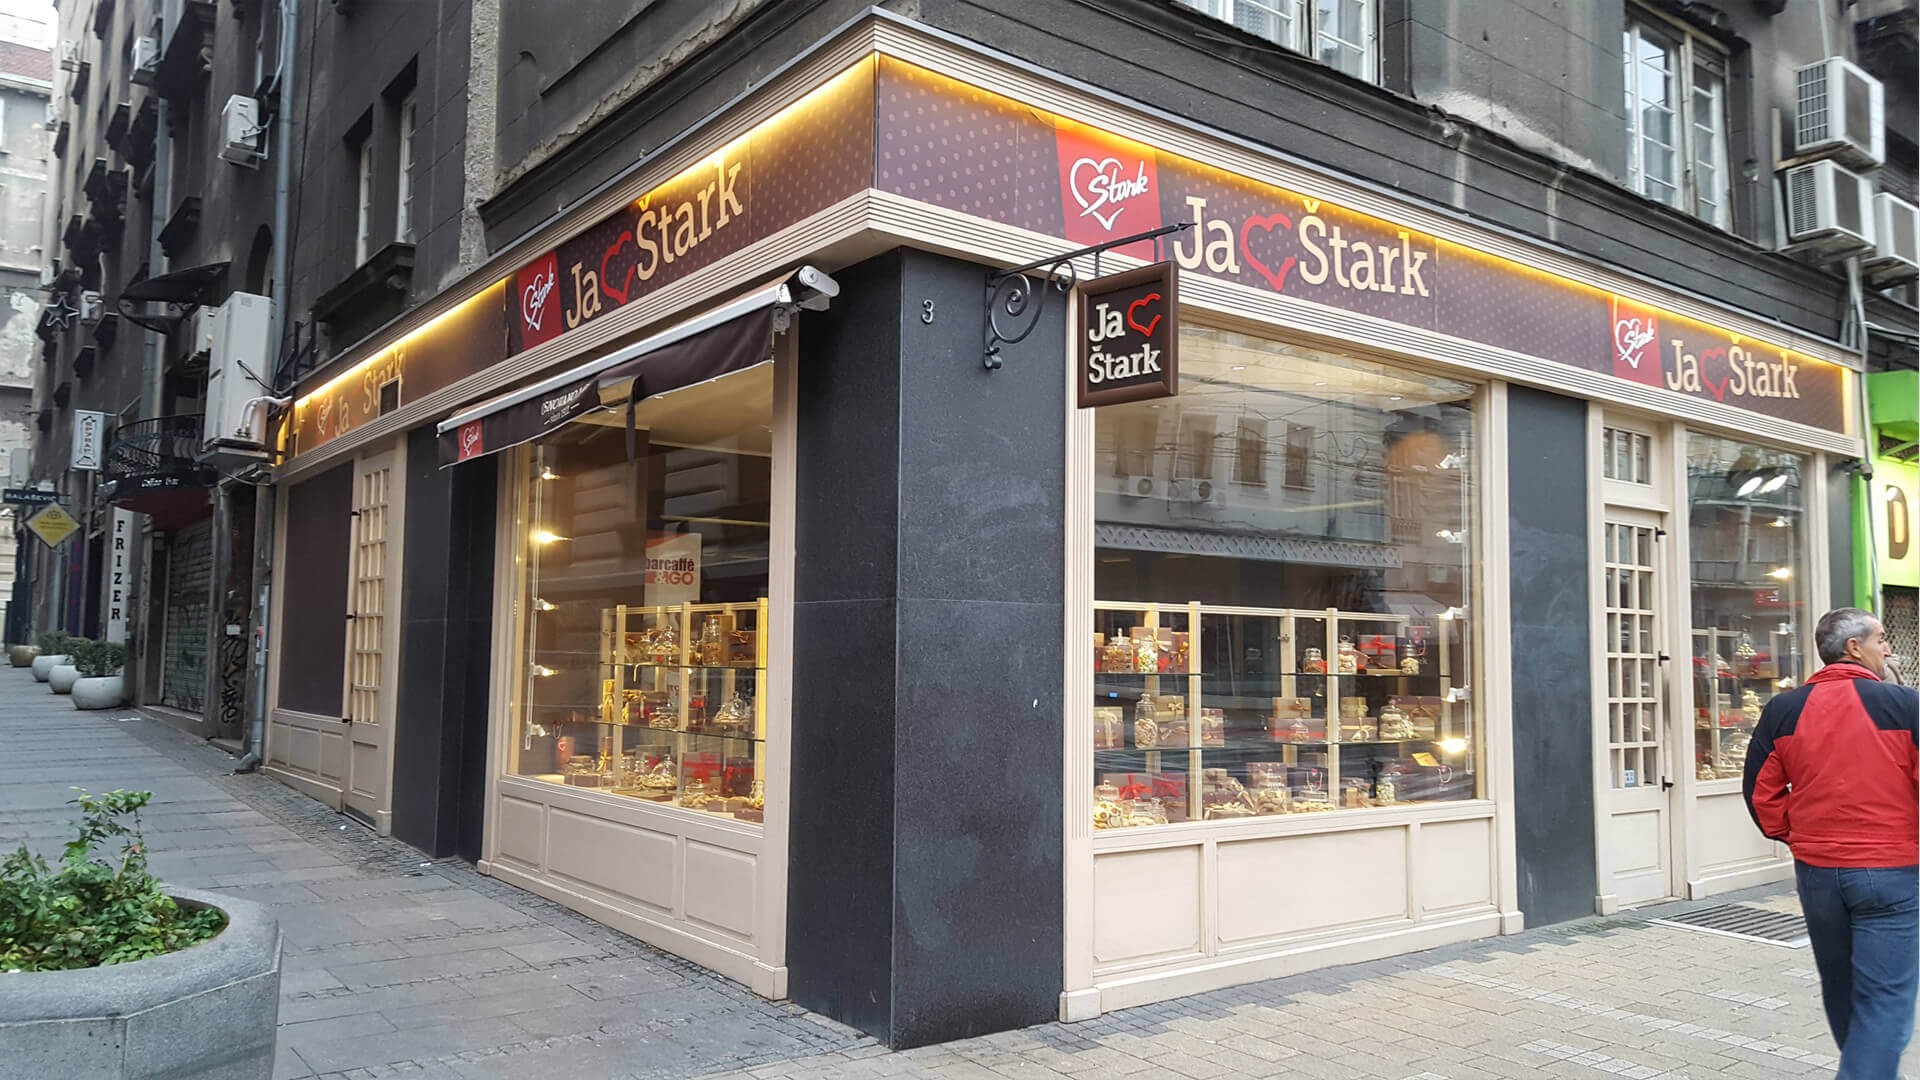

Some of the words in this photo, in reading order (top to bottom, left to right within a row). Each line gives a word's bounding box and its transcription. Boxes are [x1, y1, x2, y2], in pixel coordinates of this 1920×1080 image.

[566, 261, 602, 328] Ja
[636, 157, 743, 281] Štark
[1173, 195, 1240, 274] Ja
[1299, 200, 1429, 297] Štark
[922, 299, 934, 325] 3
[1089, 303, 1126, 342] Ja
[1089, 343, 1161, 383] Štark
[1666, 339, 1702, 392] Ja
[1728, 334, 1800, 399] Štark
[1886, 484, 1909, 560] D
[111, 519, 125, 620] FRIZER
